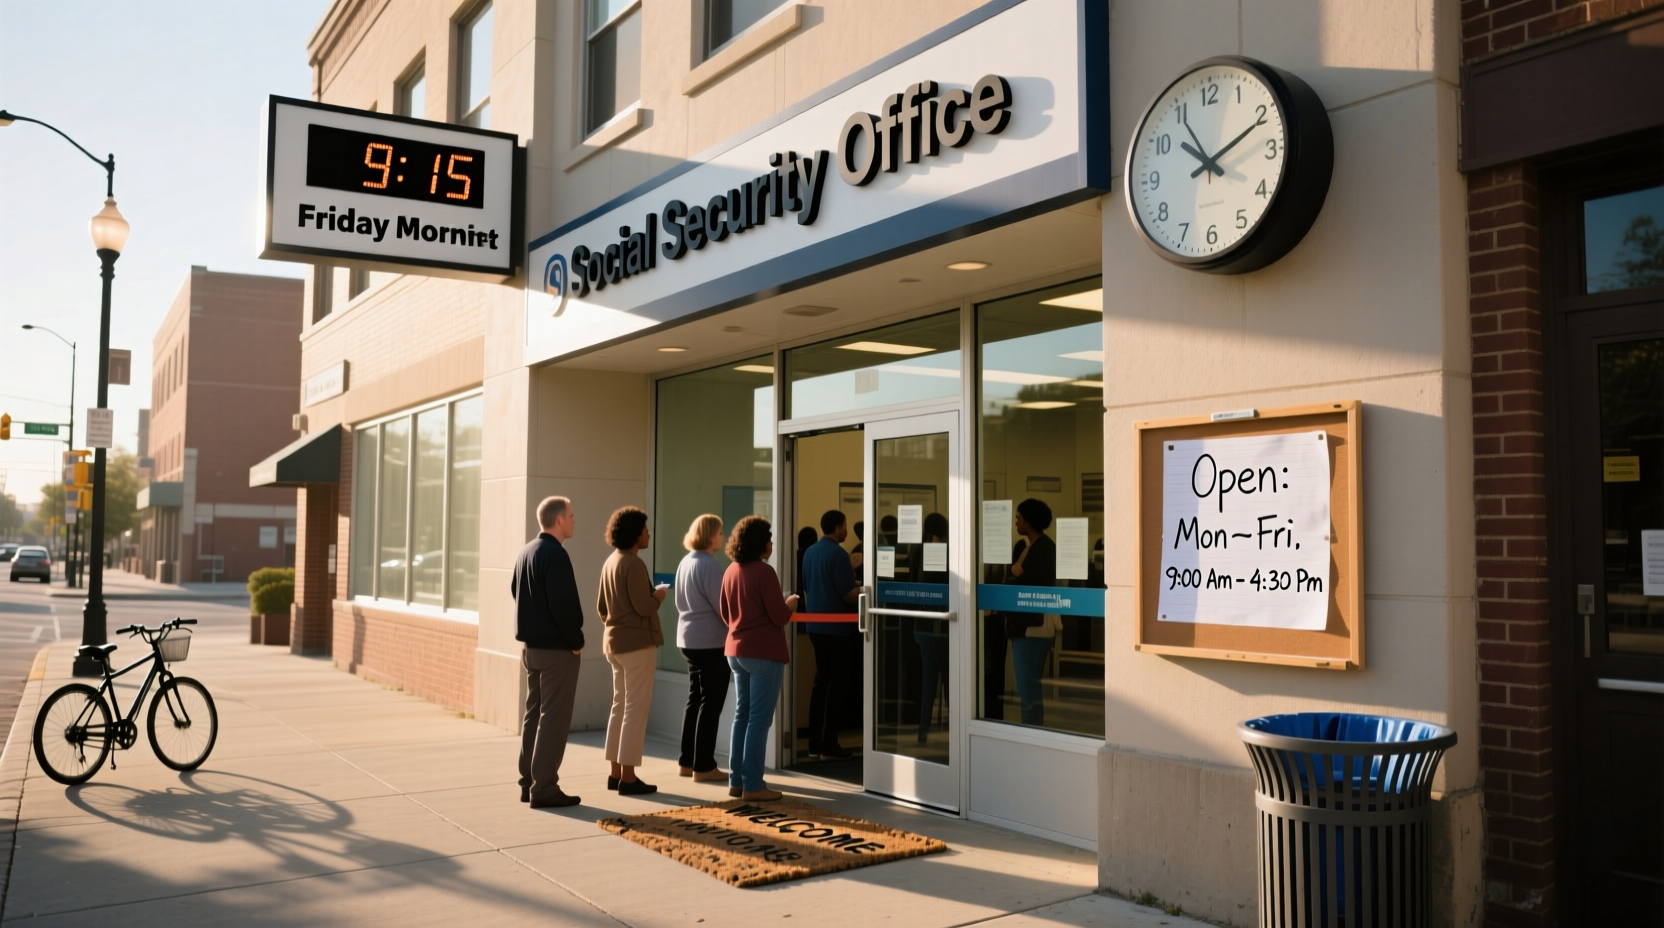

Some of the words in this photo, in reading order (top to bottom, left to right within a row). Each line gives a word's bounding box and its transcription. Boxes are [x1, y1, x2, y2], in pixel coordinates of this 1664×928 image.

[1200, 83, 1219, 107] 12
[1234, 84, 1242, 104] 1
[1174, 102, 1188, 124] 11
[1255, 104, 1268, 126] 2
[1156, 133, 1171, 155] 10
[1264, 138, 1277, 160] 3
[362, 142, 473, 200] 9:15
[1150, 171, 1160, 190] 9
[571, 213, 657, 298] Social
[661, 149, 829, 260] Security
[837, 73, 1013, 187] Office
[1254, 178, 1268, 199] 4
[1157, 201, 1169, 222] 8
[1235, 209, 1248, 229] 5
[298, 203, 390, 243] Friday
[1178, 222, 1190, 242] 7
[1206, 224, 1218, 244] 6
[1191, 453, 1289, 513] Open:
[1165, 566, 1202, 591] 9:00
[1206, 567, 1233, 590] Am
[1249, 568, 1292, 592] 4:30
[1296, 568, 1323, 592] Pm
[725, 804, 886, 854] WELCOME
